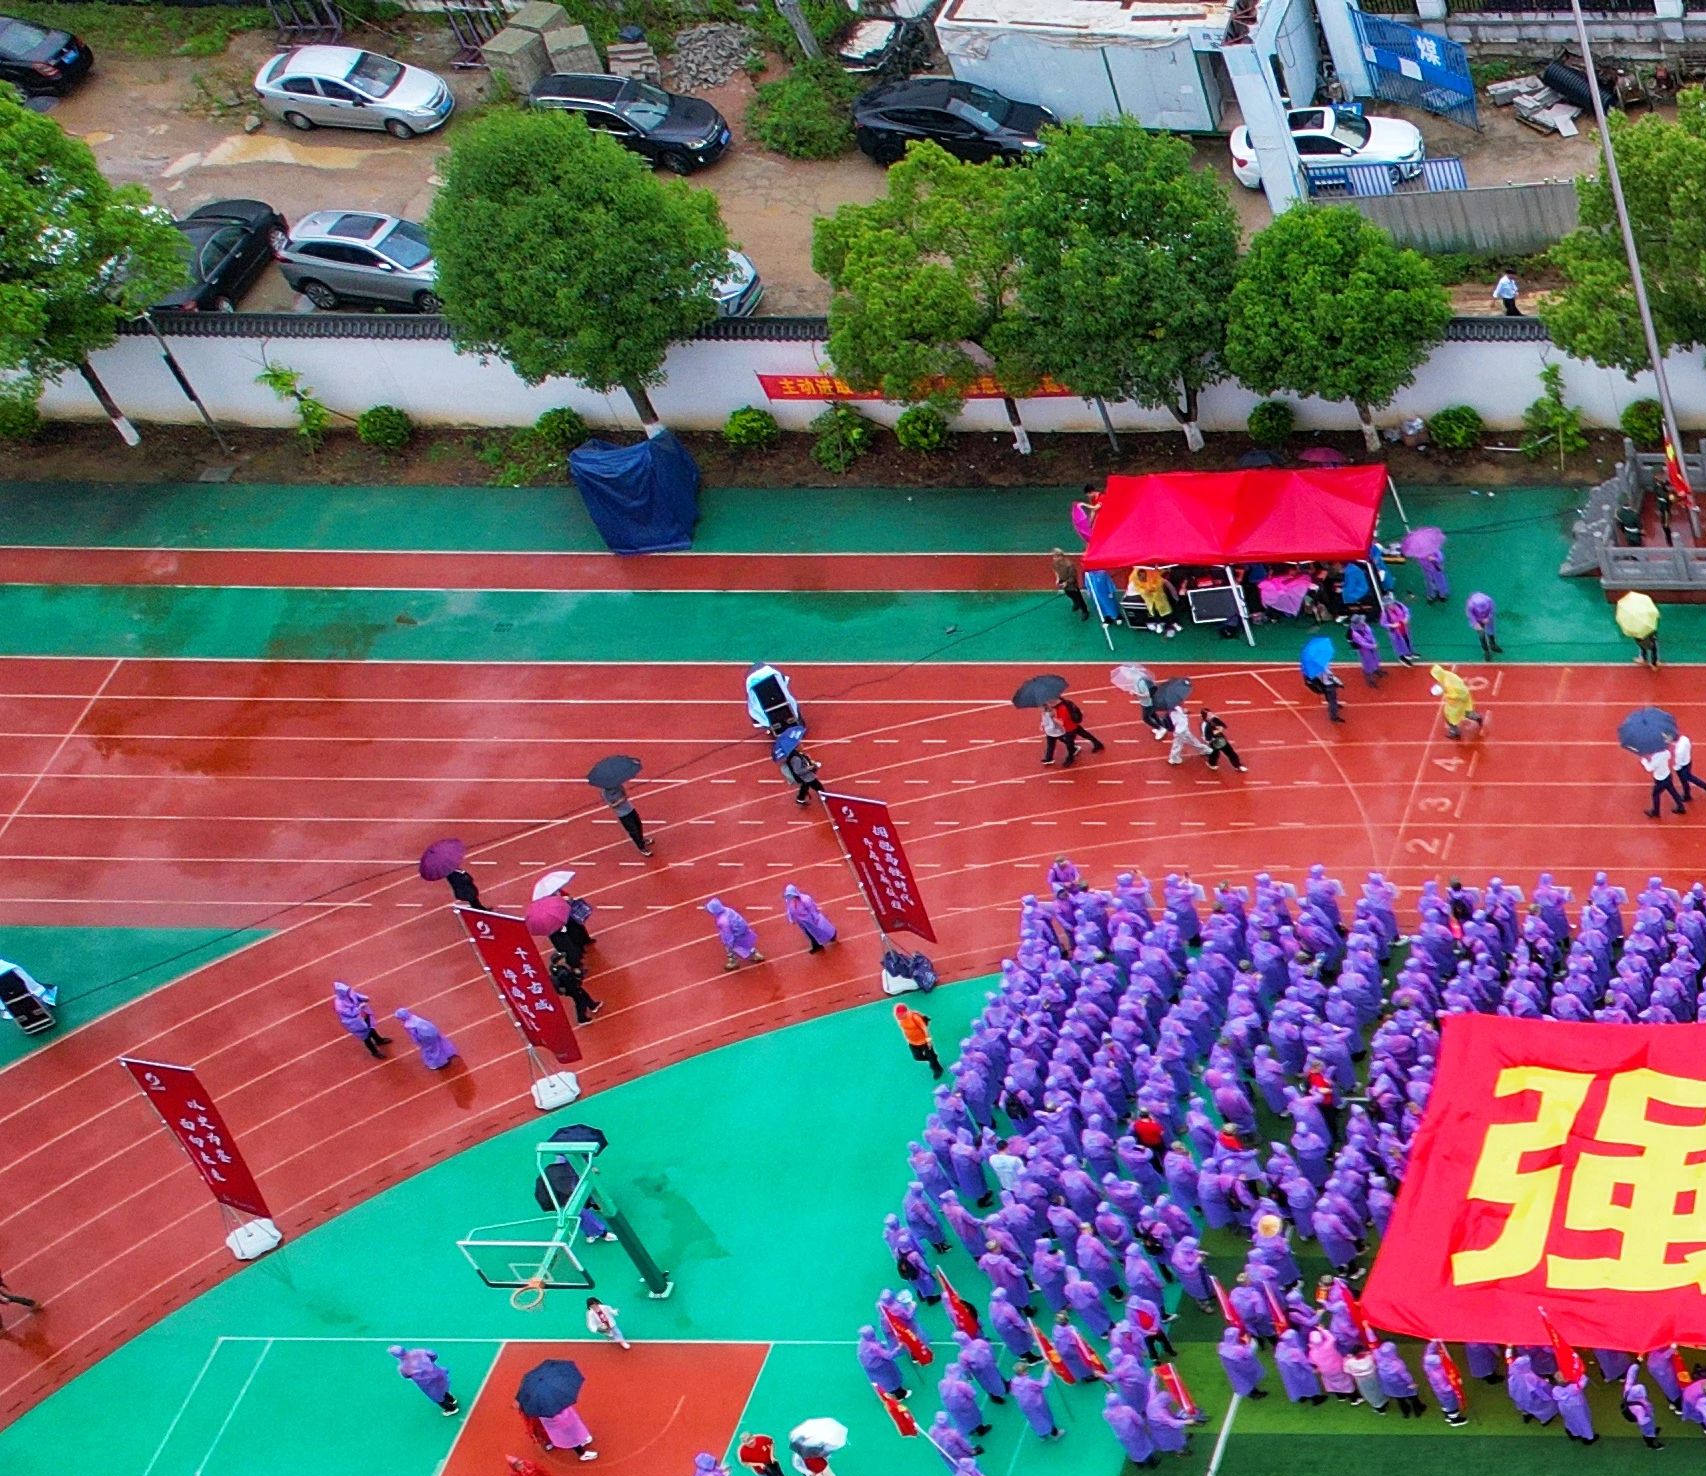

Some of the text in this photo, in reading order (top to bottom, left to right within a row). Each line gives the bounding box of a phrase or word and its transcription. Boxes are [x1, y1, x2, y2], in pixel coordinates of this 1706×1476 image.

[1432, 756, 1465, 773] 4
[1418, 797, 1452, 812] 3
[1405, 837, 1440, 855] 2
